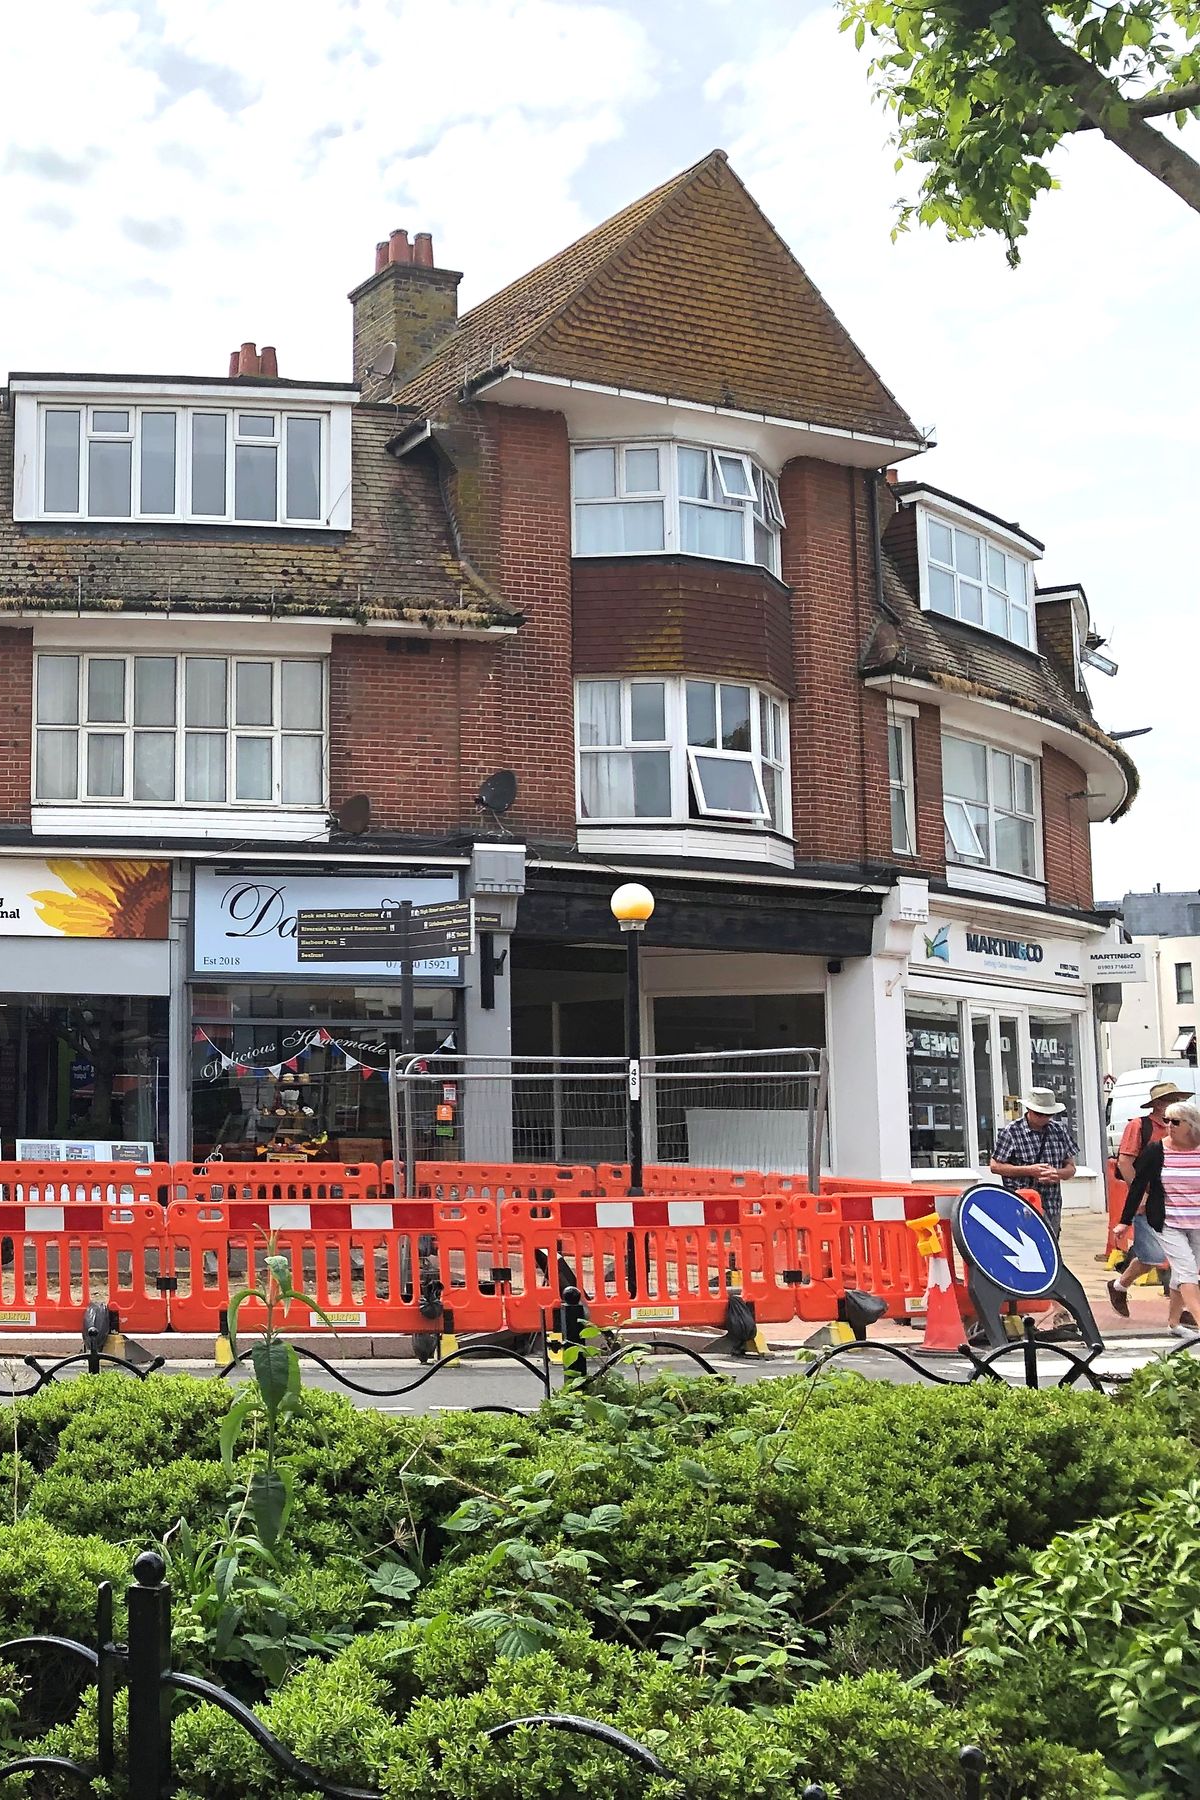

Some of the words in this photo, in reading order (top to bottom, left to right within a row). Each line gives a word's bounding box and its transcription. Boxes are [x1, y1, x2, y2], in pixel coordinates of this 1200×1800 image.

[966, 933, 1043, 962] MARTIN&CO
[203, 957, 217, 965] Est
[219, 957, 240, 965] 2018
[424, 960, 450, 969] 15921
